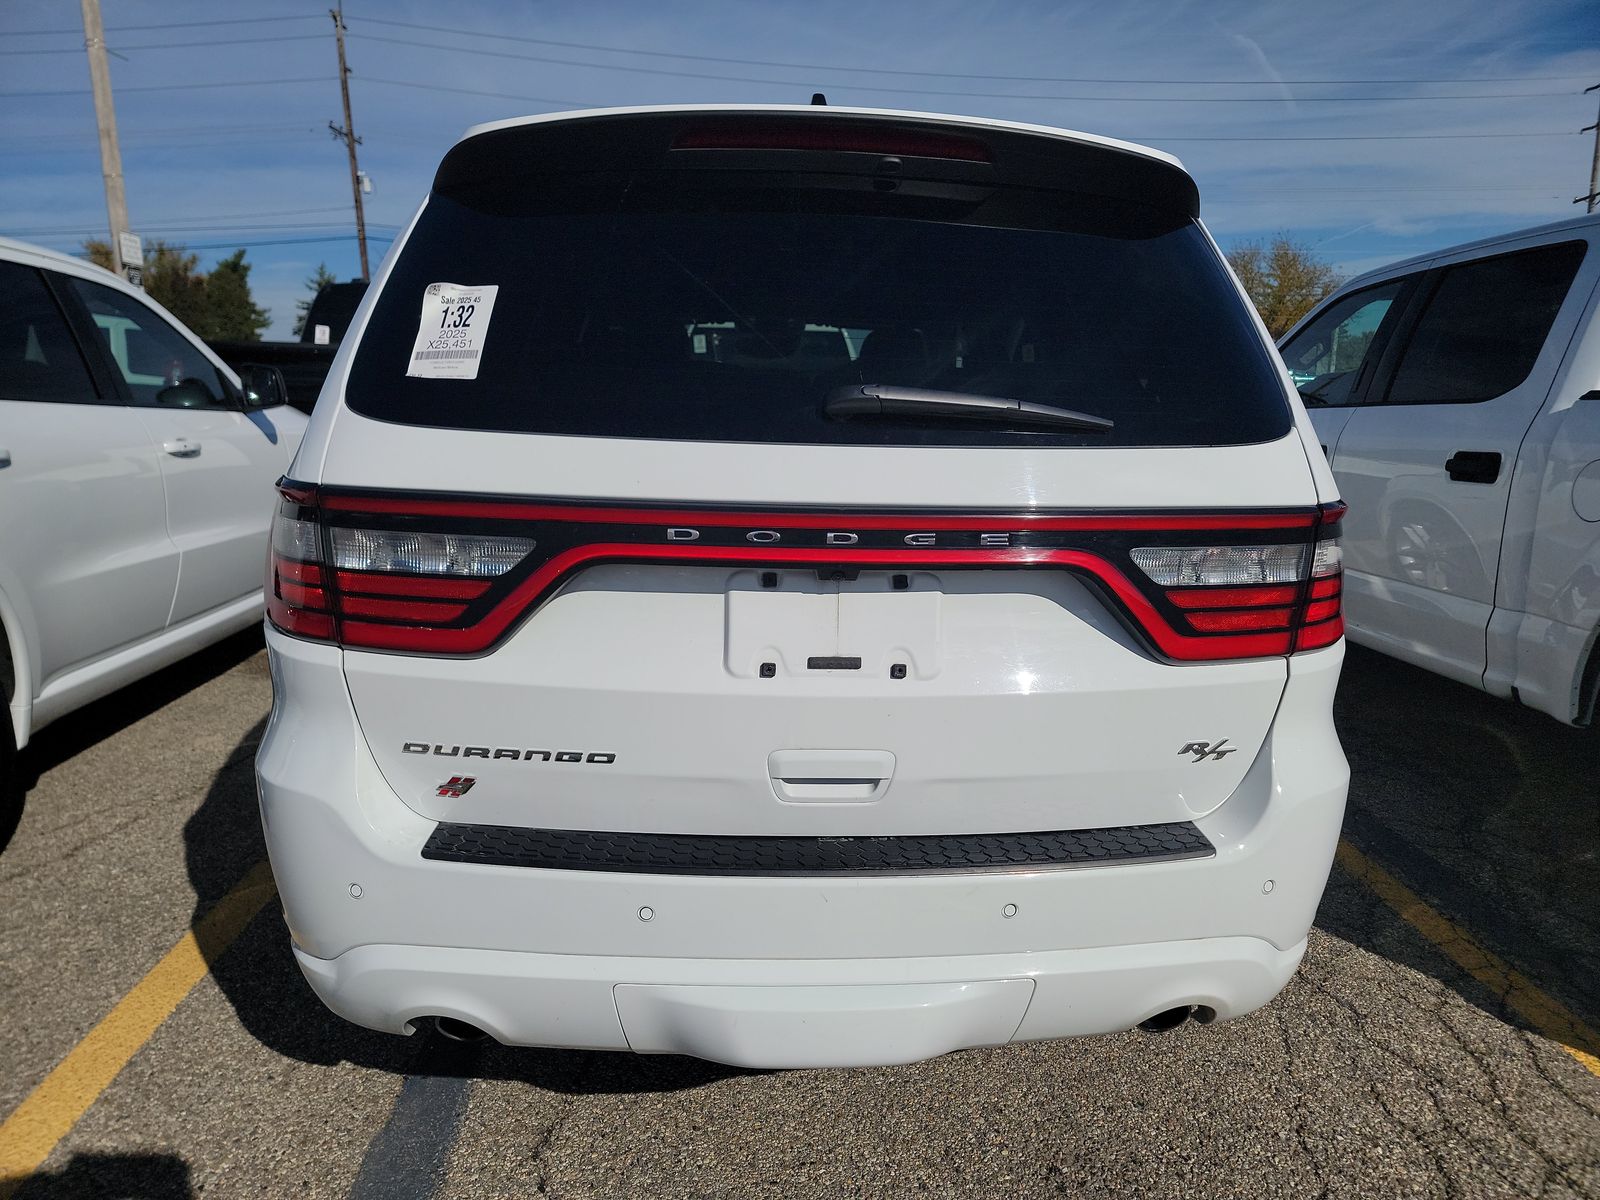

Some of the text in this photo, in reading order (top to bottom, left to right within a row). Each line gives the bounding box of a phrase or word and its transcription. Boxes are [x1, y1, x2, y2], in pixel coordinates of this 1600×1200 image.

[441, 296, 455, 304] Sale
[457, 296, 472, 304] 2025
[441, 304, 475, 328] 1:32
[439, 329, 467, 339] 2025
[427, 340, 473, 350] X25,451
[667, 527, 1010, 546] DODGE
[402, 742, 617, 764] DURANGO
[1177, 737, 1237, 763] R/T
